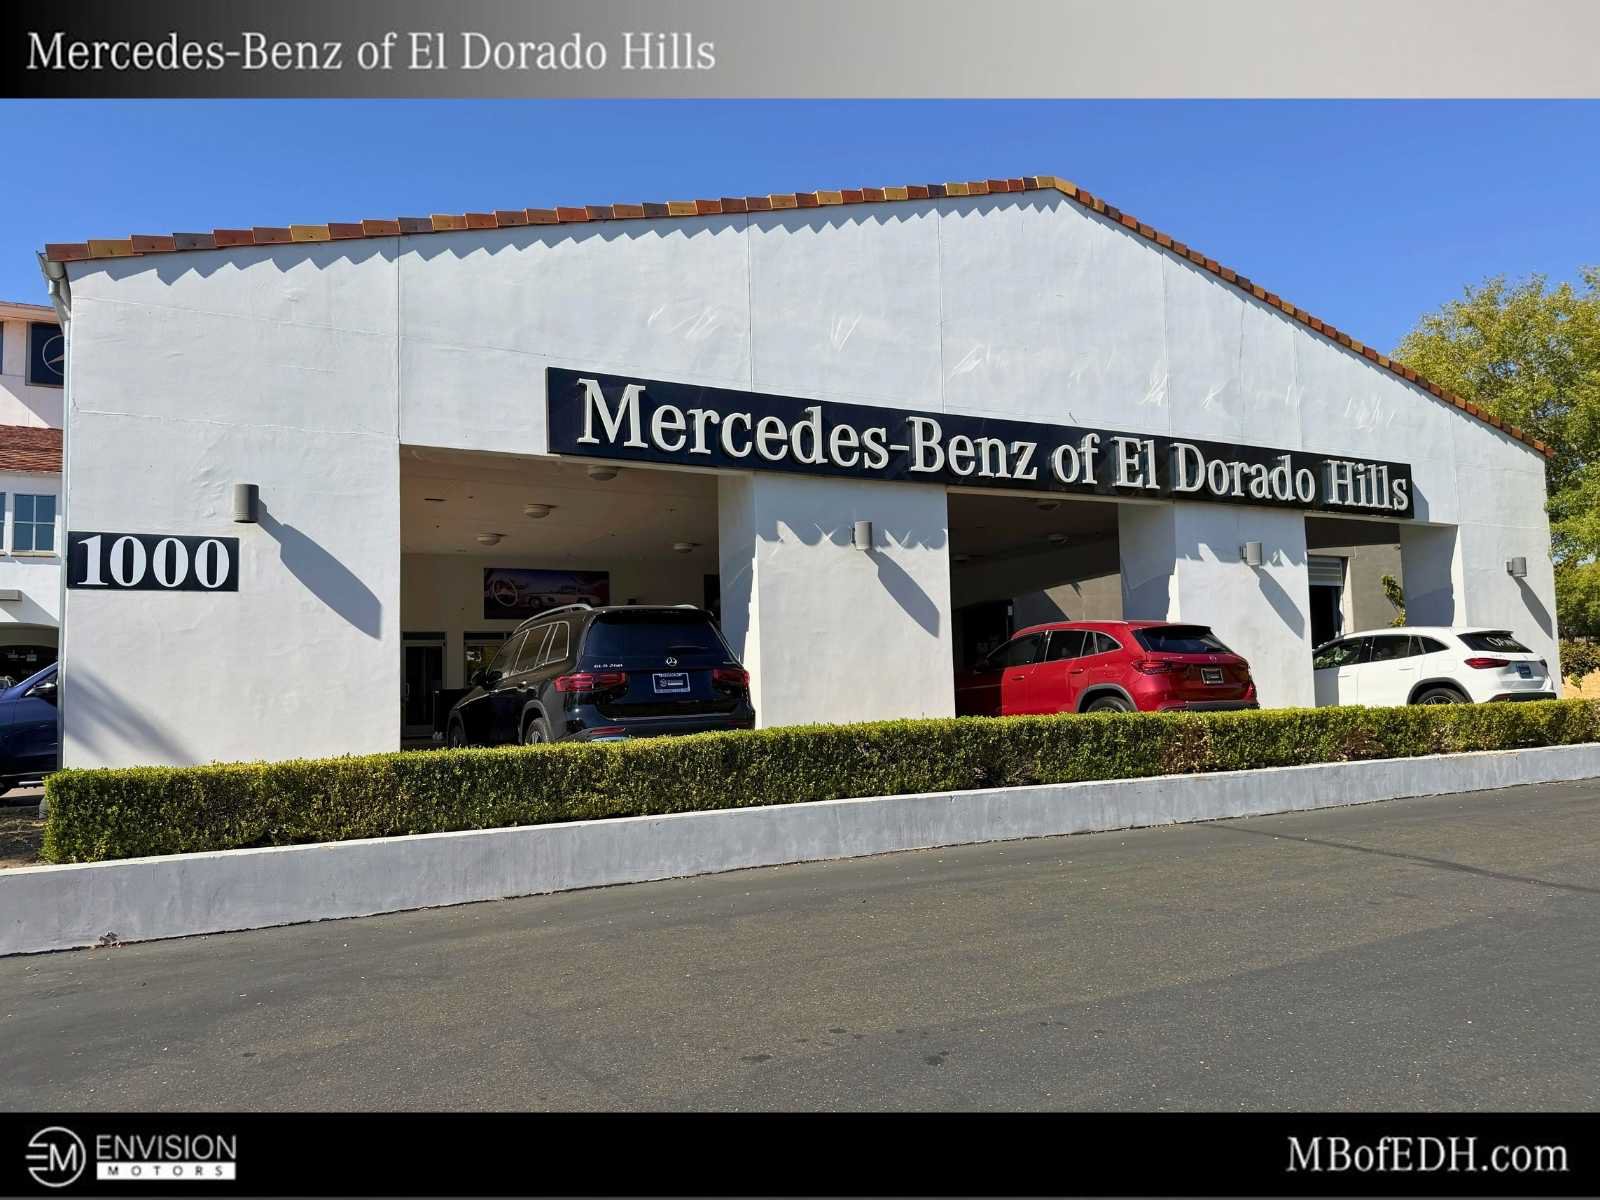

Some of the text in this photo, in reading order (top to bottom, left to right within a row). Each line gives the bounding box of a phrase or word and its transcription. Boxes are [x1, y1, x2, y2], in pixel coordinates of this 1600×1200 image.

[577, 378, 1409, 511] Mercedes-Benz of El Dorado Hills
[77, 534, 230, 588] 1000
